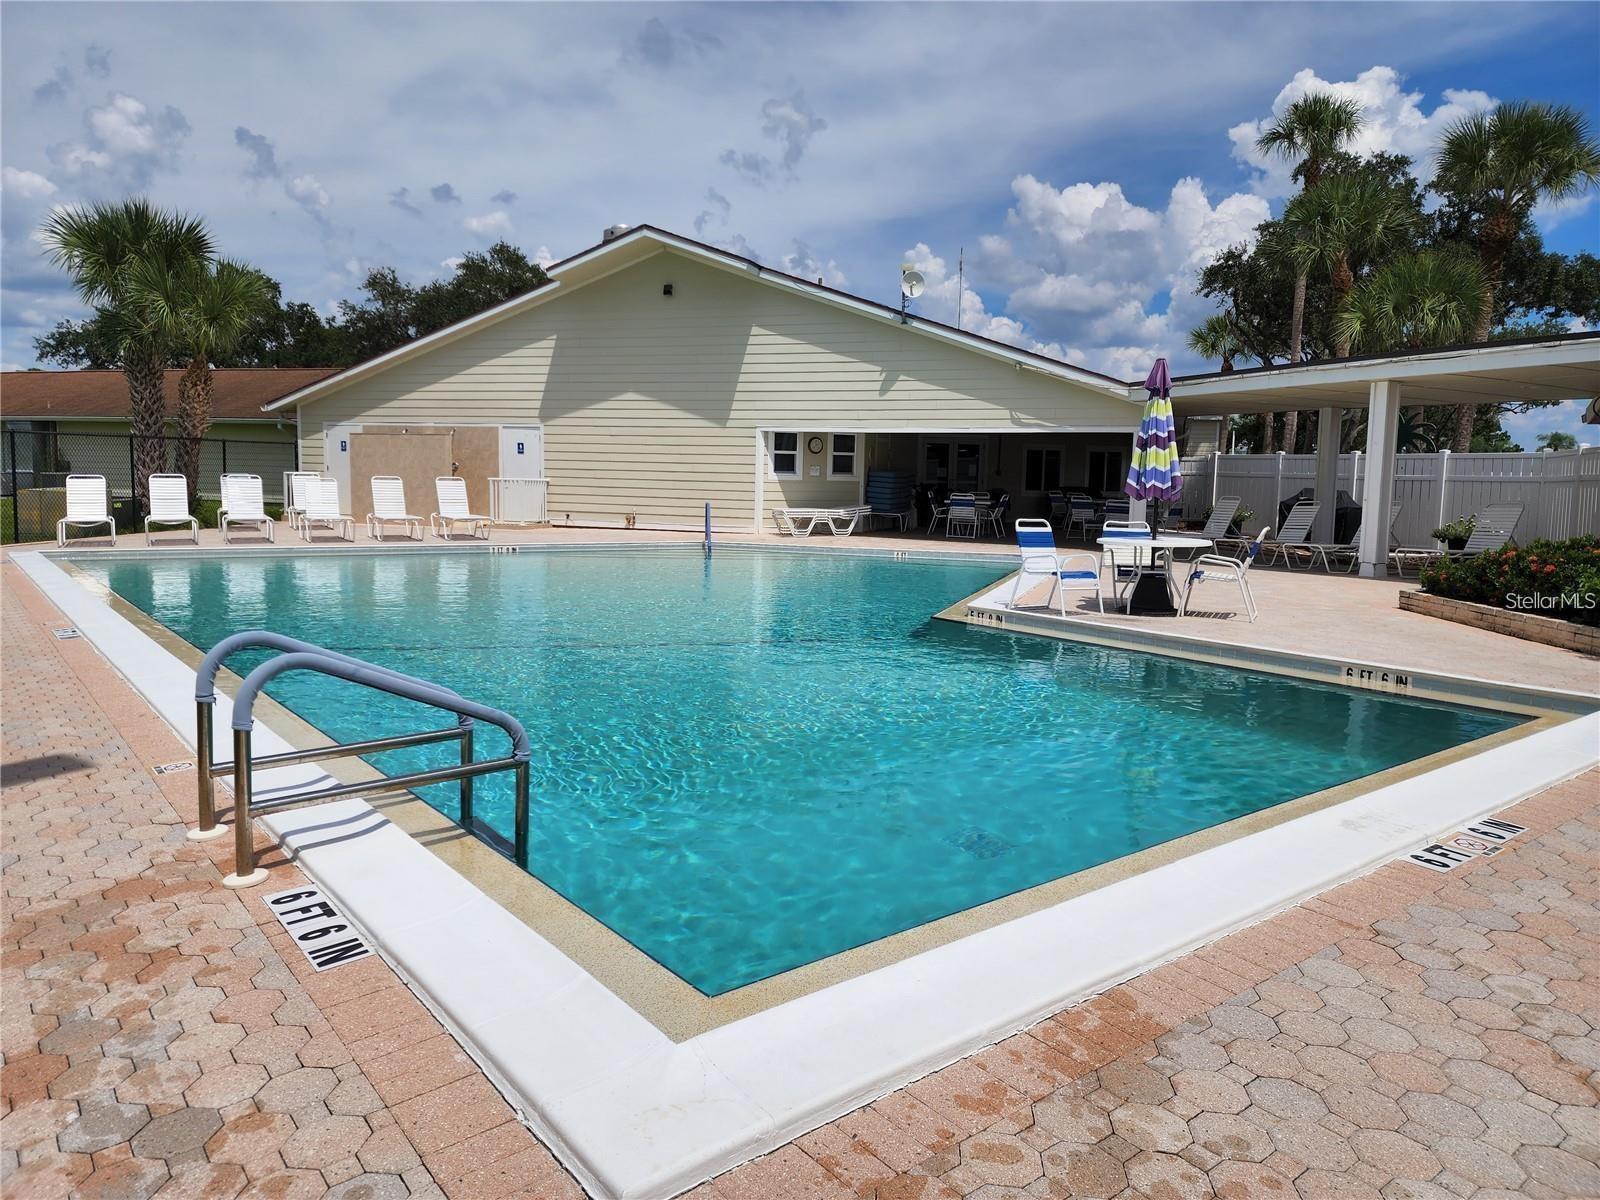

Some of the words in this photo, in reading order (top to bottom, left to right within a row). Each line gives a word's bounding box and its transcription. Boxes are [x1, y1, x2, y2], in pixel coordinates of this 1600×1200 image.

[1467, 827, 1506, 840] 6
[1478, 818, 1525, 834] IN
[1422, 843, 1472, 862] FT
[1410, 854, 1451, 868] 6
[271, 890, 318, 905] 6
[279, 901, 338, 926] FT
[298, 924, 348, 941] 6
[308, 937, 370, 968] IN
